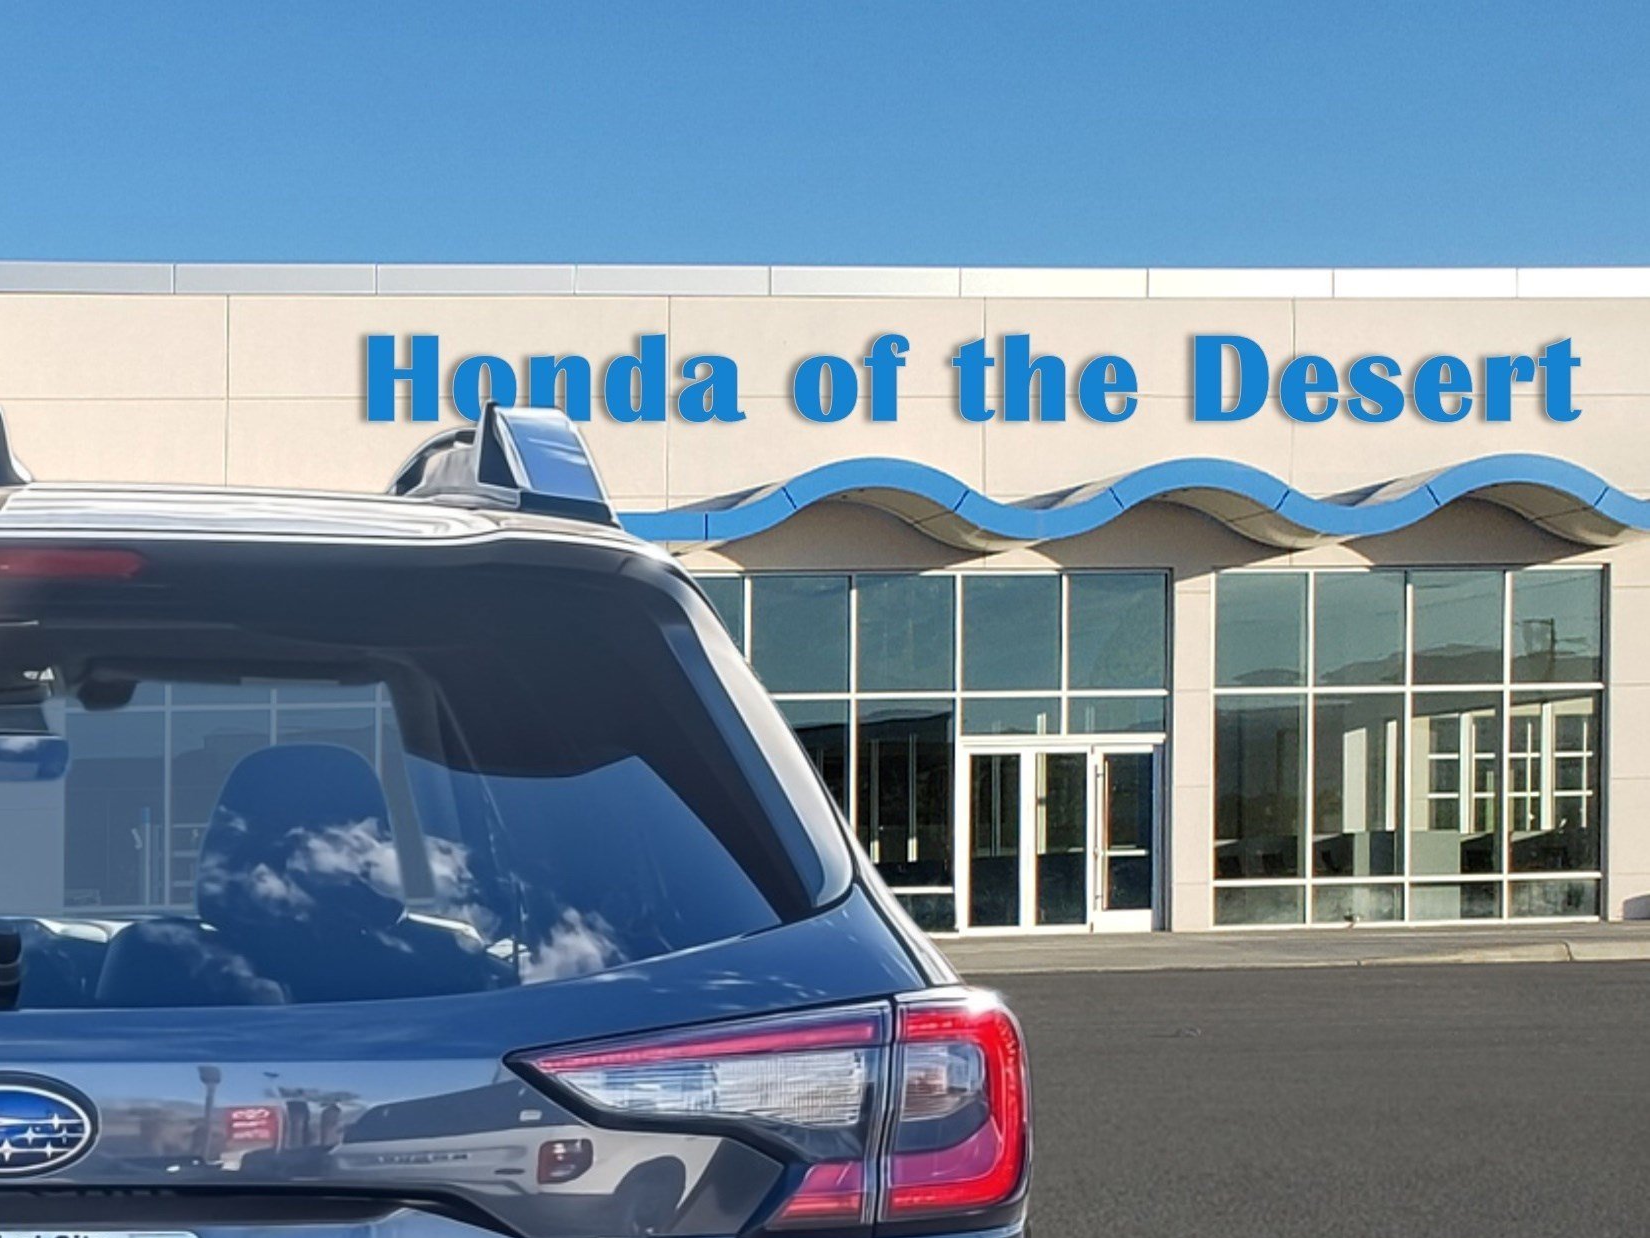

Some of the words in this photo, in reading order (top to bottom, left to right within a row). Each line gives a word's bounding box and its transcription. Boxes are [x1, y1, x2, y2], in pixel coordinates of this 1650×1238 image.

[365, 335, 746, 424] Honda
[794, 335, 910, 424] of
[953, 335, 1138, 424] the
[1195, 335, 1582, 424] Desert
